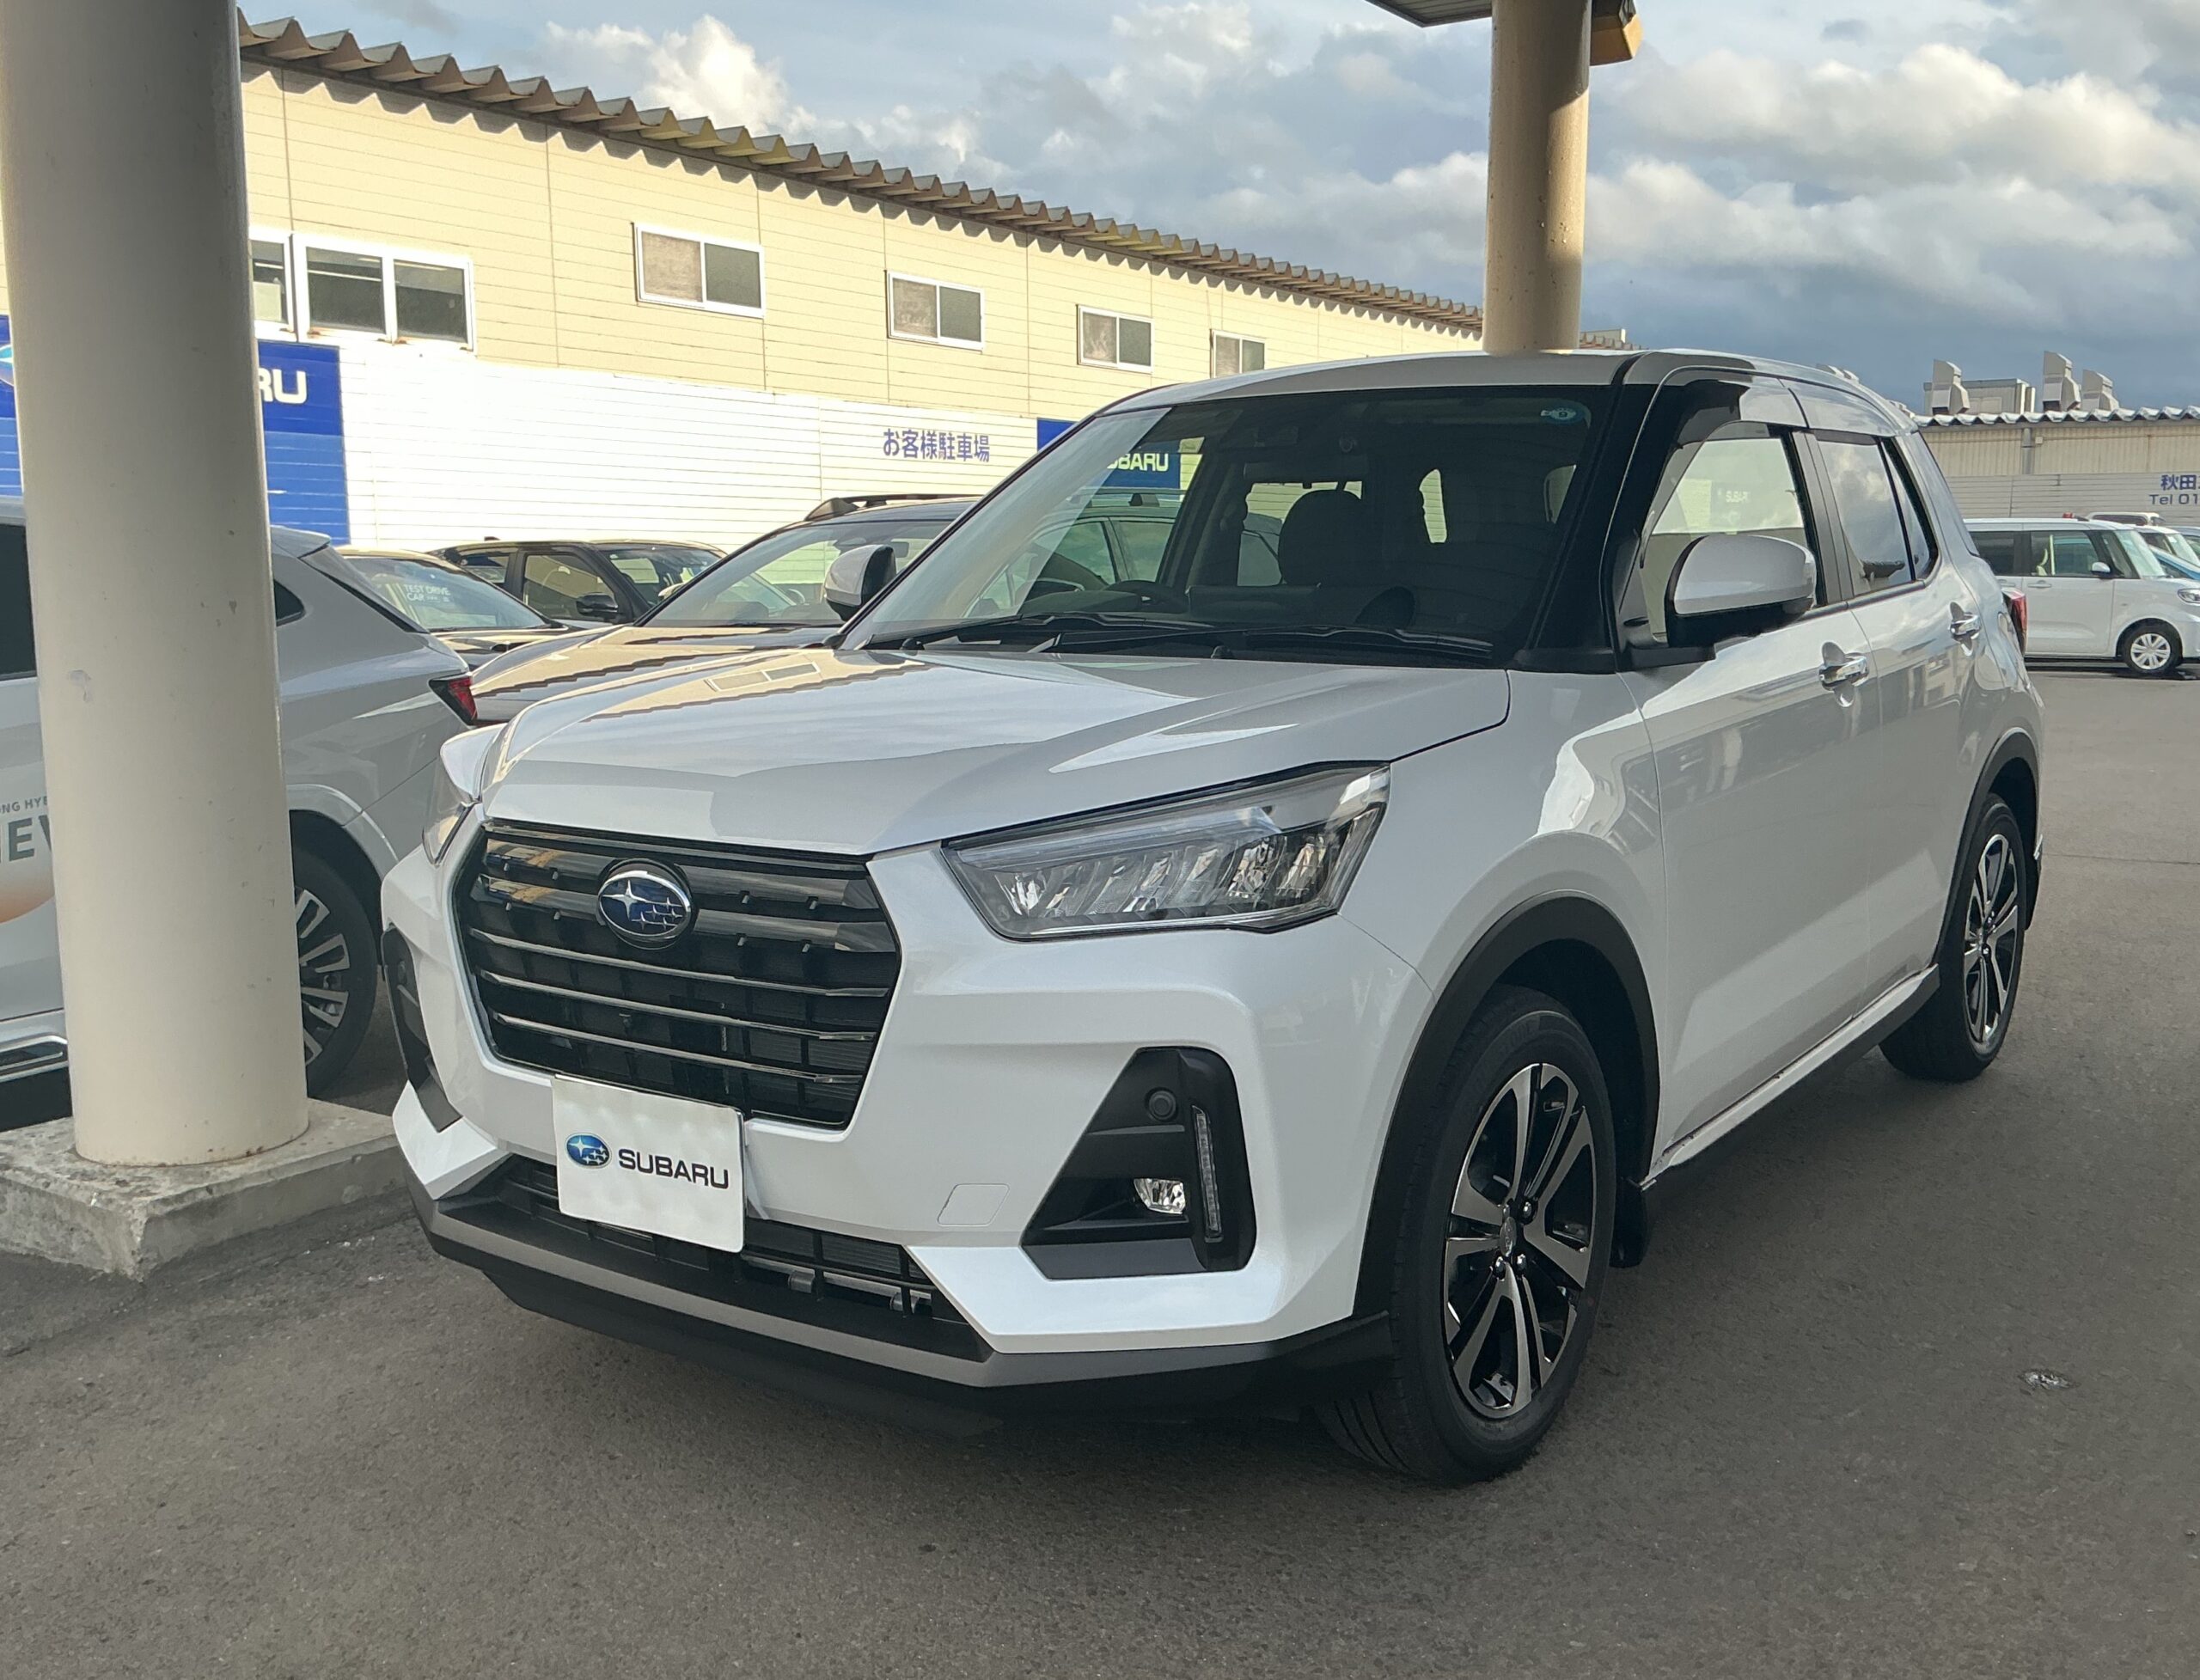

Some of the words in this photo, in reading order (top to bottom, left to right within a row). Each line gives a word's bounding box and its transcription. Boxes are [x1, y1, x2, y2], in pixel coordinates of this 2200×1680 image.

[883, 428, 990, 462] お客様駐車場
[2160, 474, 2200, 491] 秋田
[2149, 493, 2173, 505] Tel
[0, 801, 21, 814] NG
[618, 1148, 730, 1189] SUBARU
